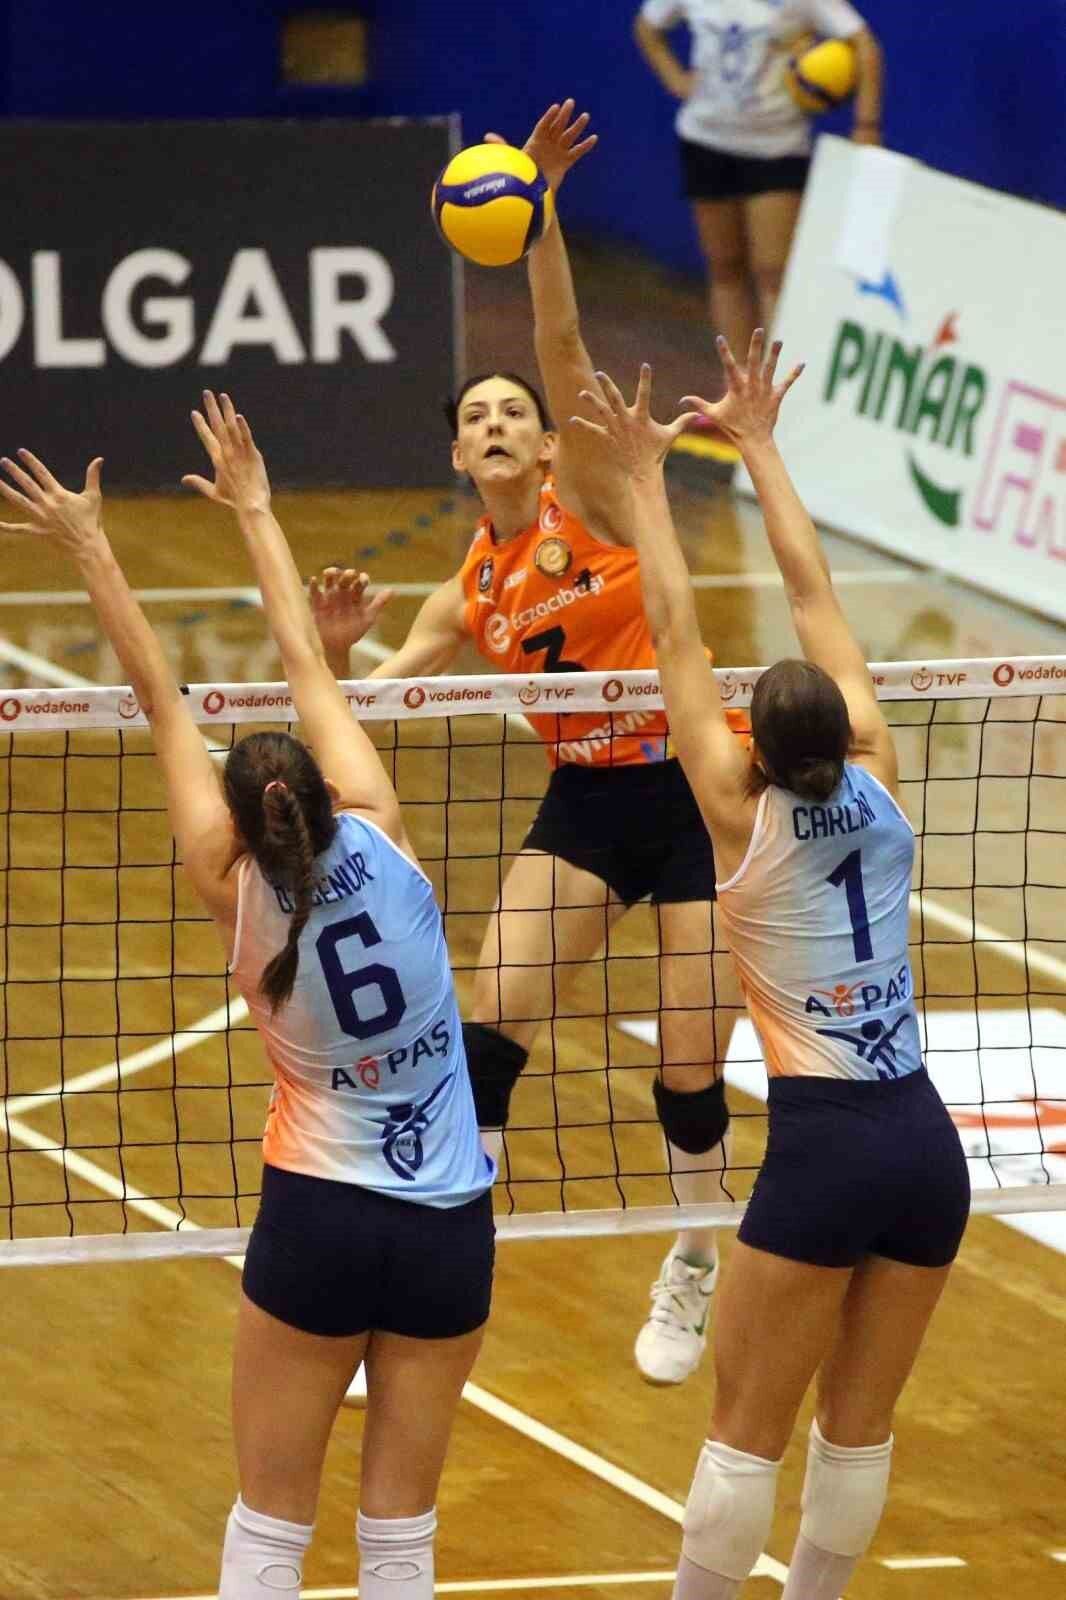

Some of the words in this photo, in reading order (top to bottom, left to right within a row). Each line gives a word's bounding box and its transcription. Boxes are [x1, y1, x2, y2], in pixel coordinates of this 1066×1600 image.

[25, 701, 90, 714] vodafone
[429, 688, 493, 703] vodafone
[543, 687, 576, 700] TVF
[627, 682, 663, 696] voda
[935, 672, 967, 687] TVF
[1018, 666, 1066, 680] vodafo
[826, 848, 873, 962] 1
[315, 910, 406, 1040] 6
